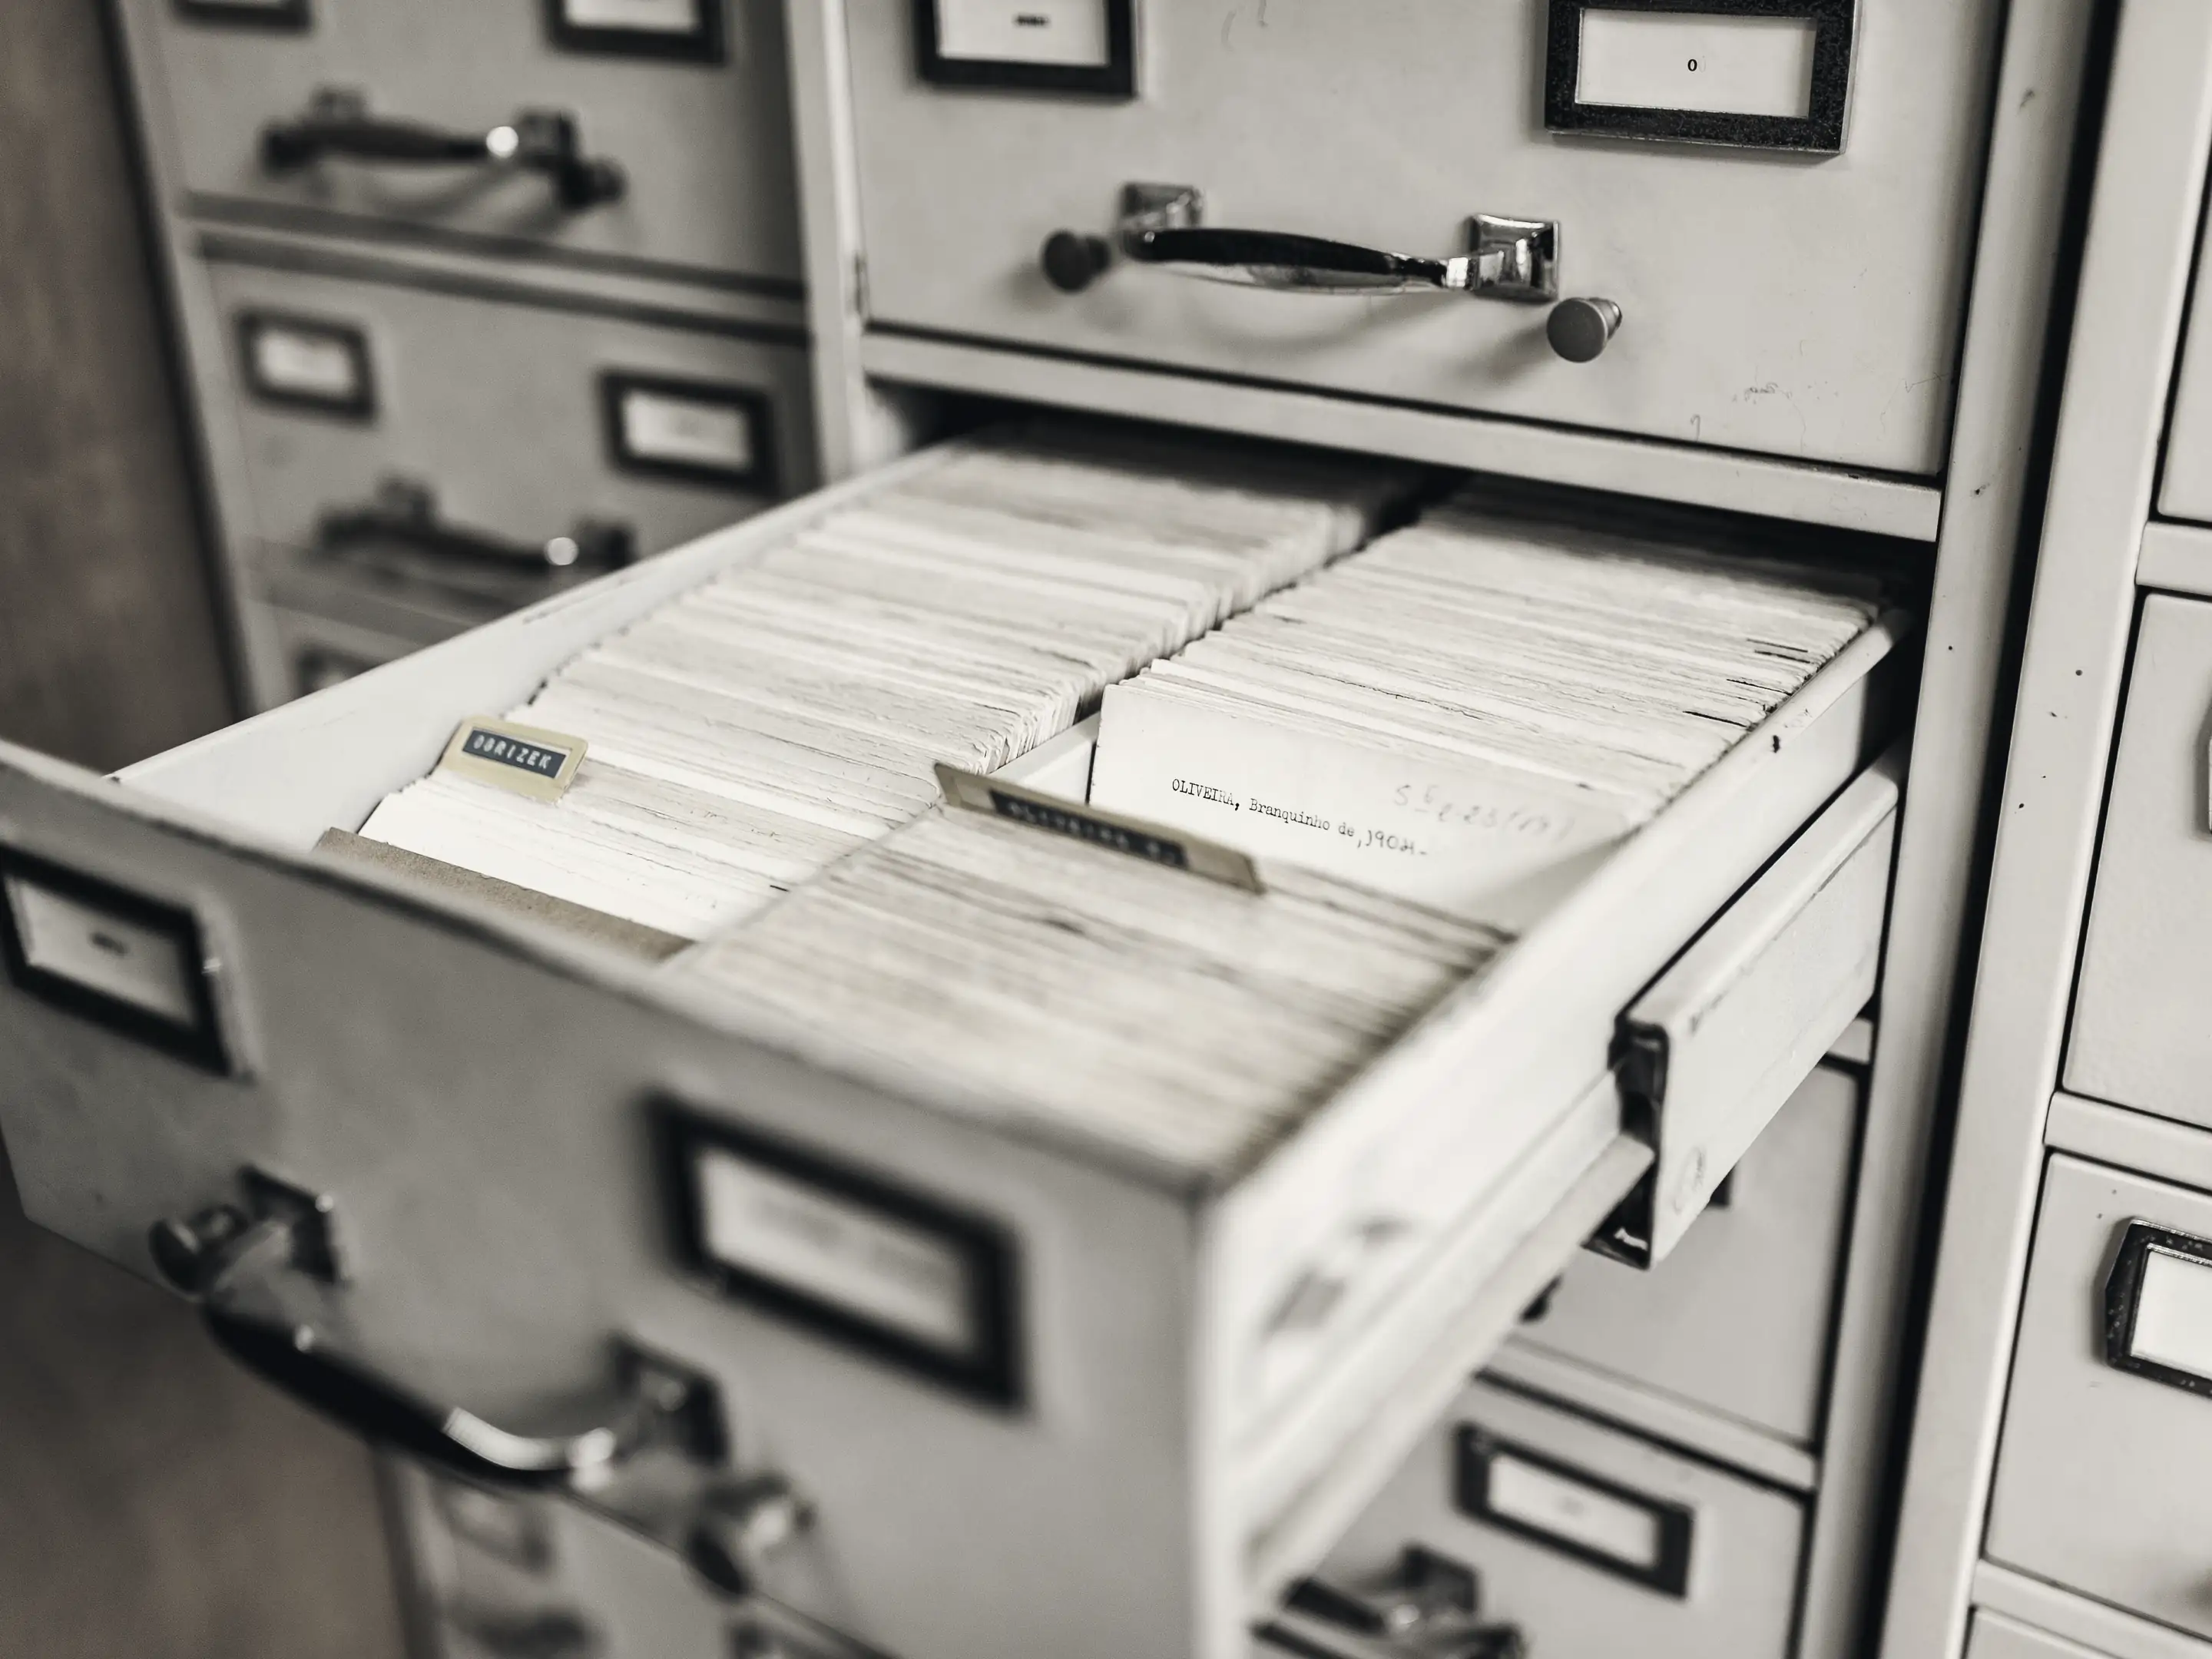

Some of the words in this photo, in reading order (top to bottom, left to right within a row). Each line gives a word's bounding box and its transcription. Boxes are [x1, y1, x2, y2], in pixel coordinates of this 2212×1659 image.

[472, 734, 553, 770] OBRIZEK
[1171, 778, 1240, 811] OLIVEIRA,
[1248, 797, 1331, 831] Branquinho
